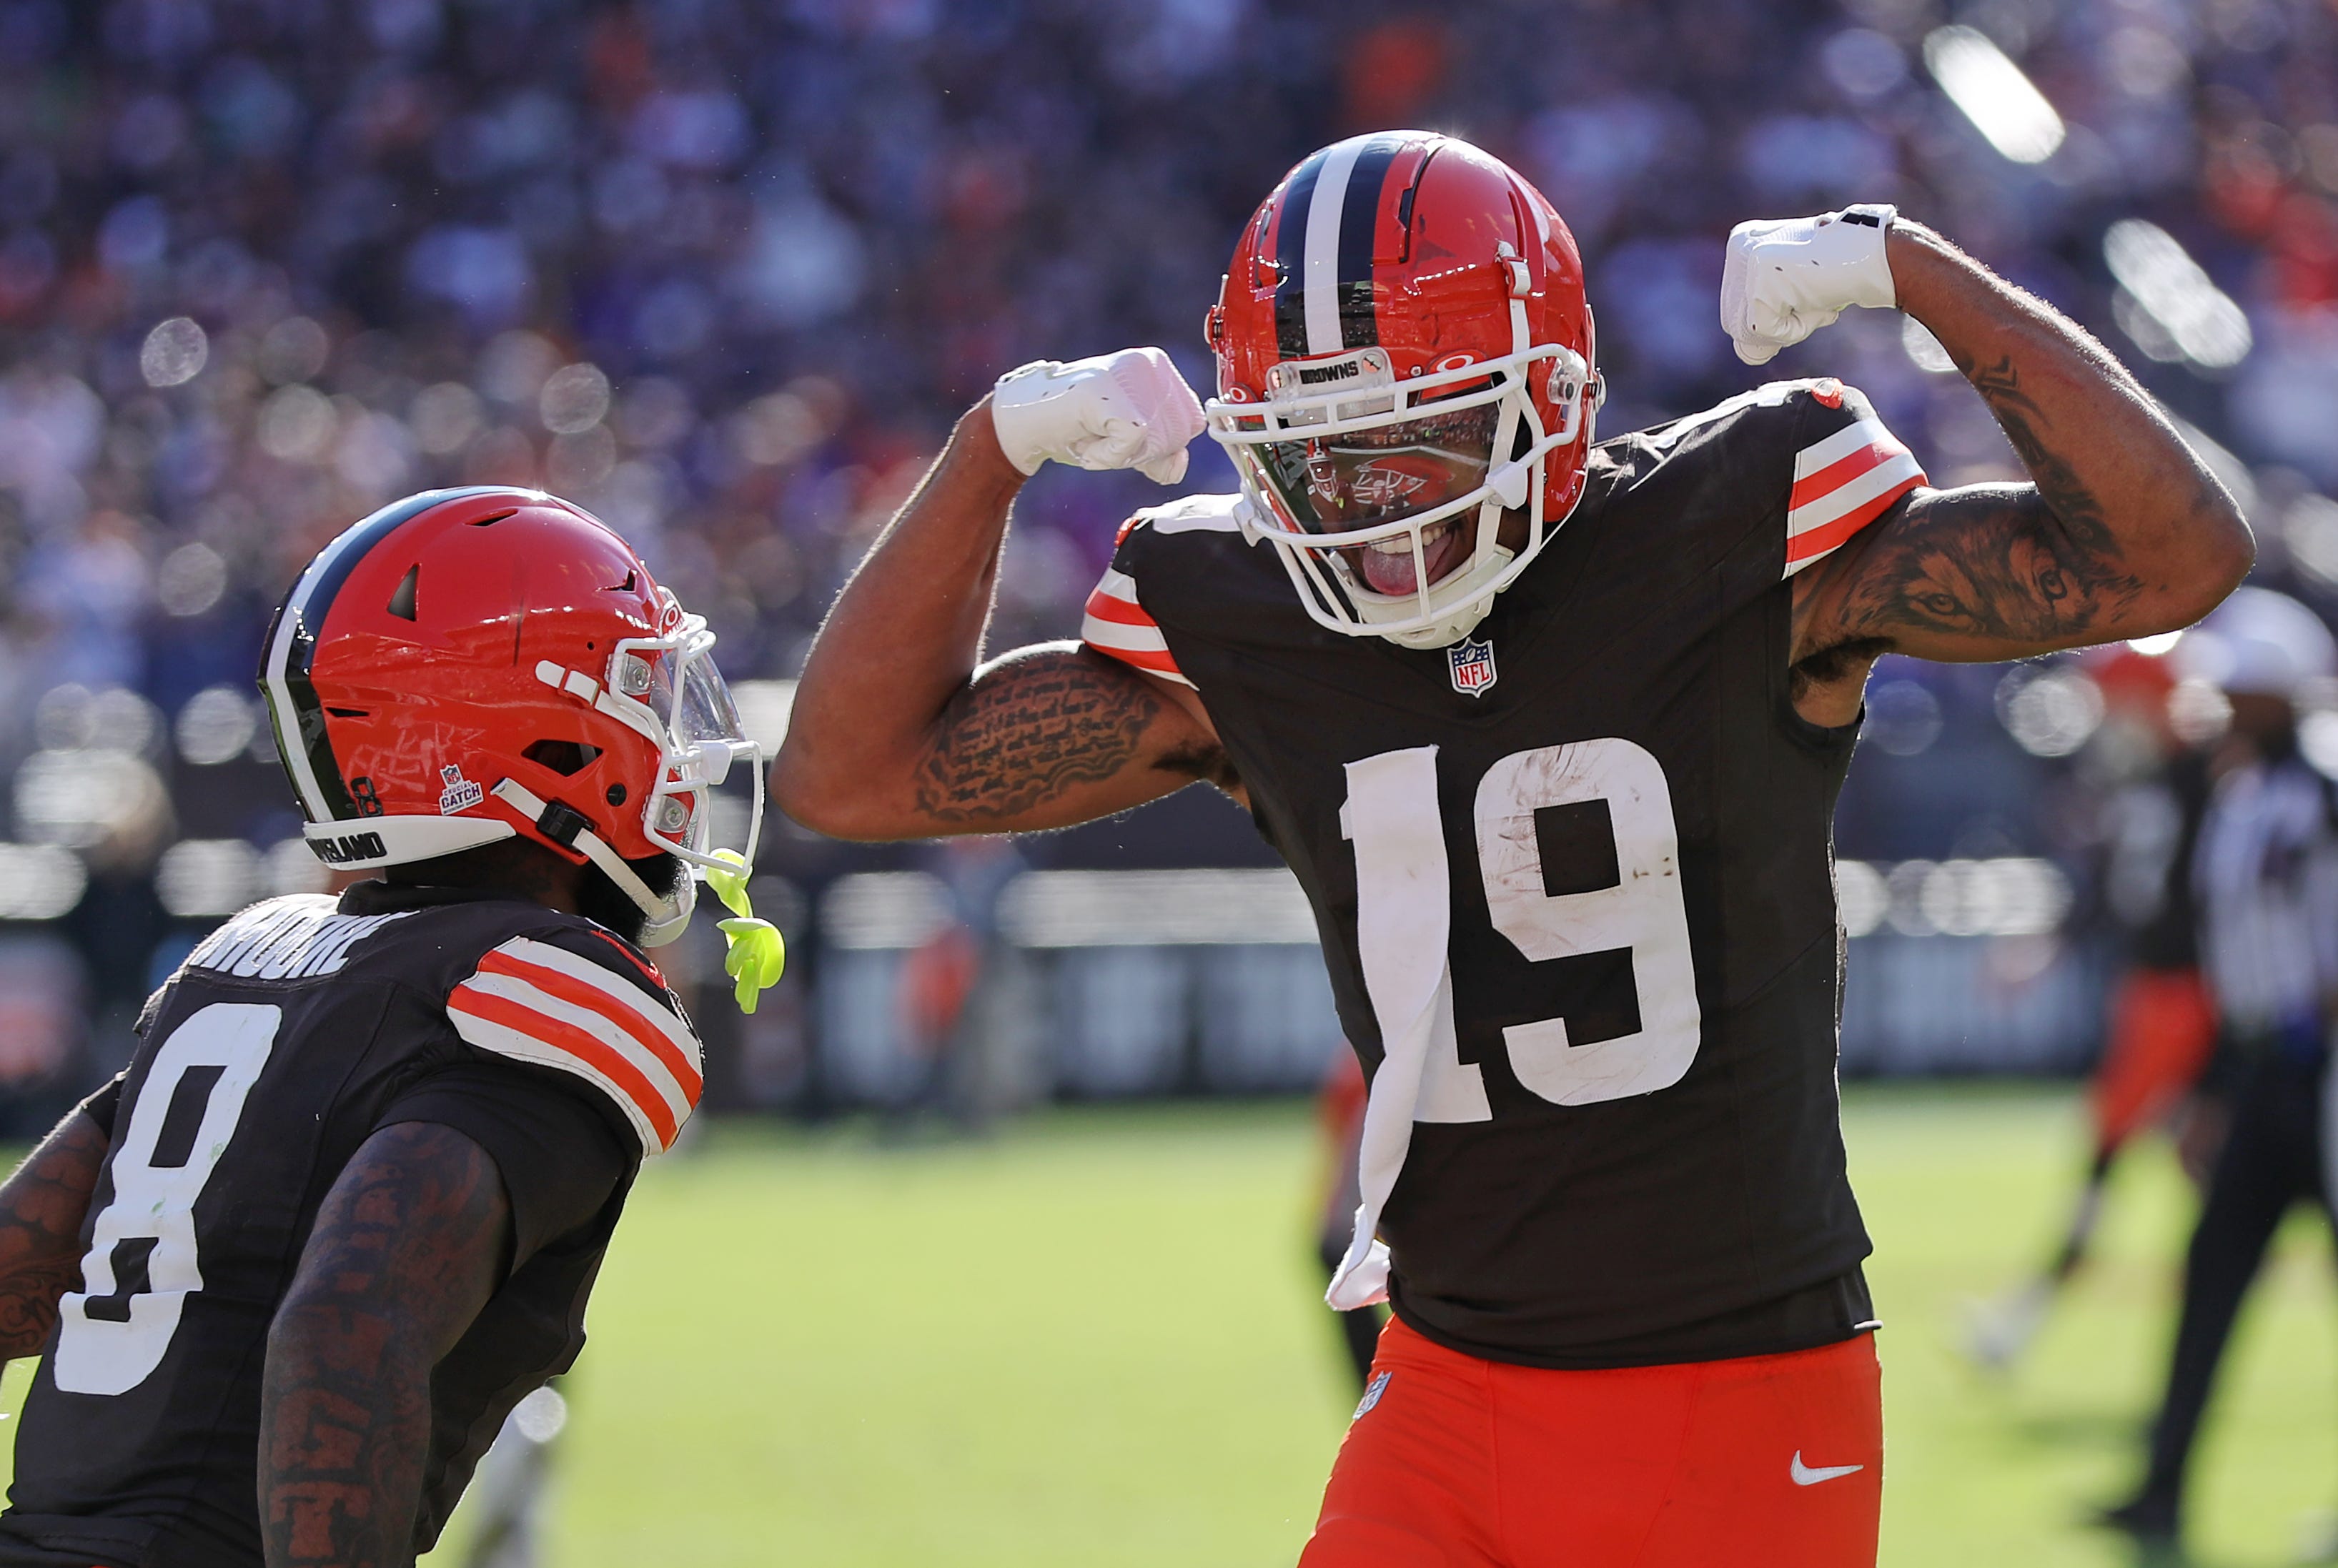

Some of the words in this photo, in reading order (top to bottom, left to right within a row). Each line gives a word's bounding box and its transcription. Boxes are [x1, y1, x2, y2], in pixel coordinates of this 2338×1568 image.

[1299, 360, 1359, 384] BROWNS
[1457, 662, 1490, 686] NFL
[447, 772, 461, 783] NFL
[350, 776, 384, 816] 8
[441, 784, 481, 809] CATCH
[54, 1002, 282, 1396] 8
